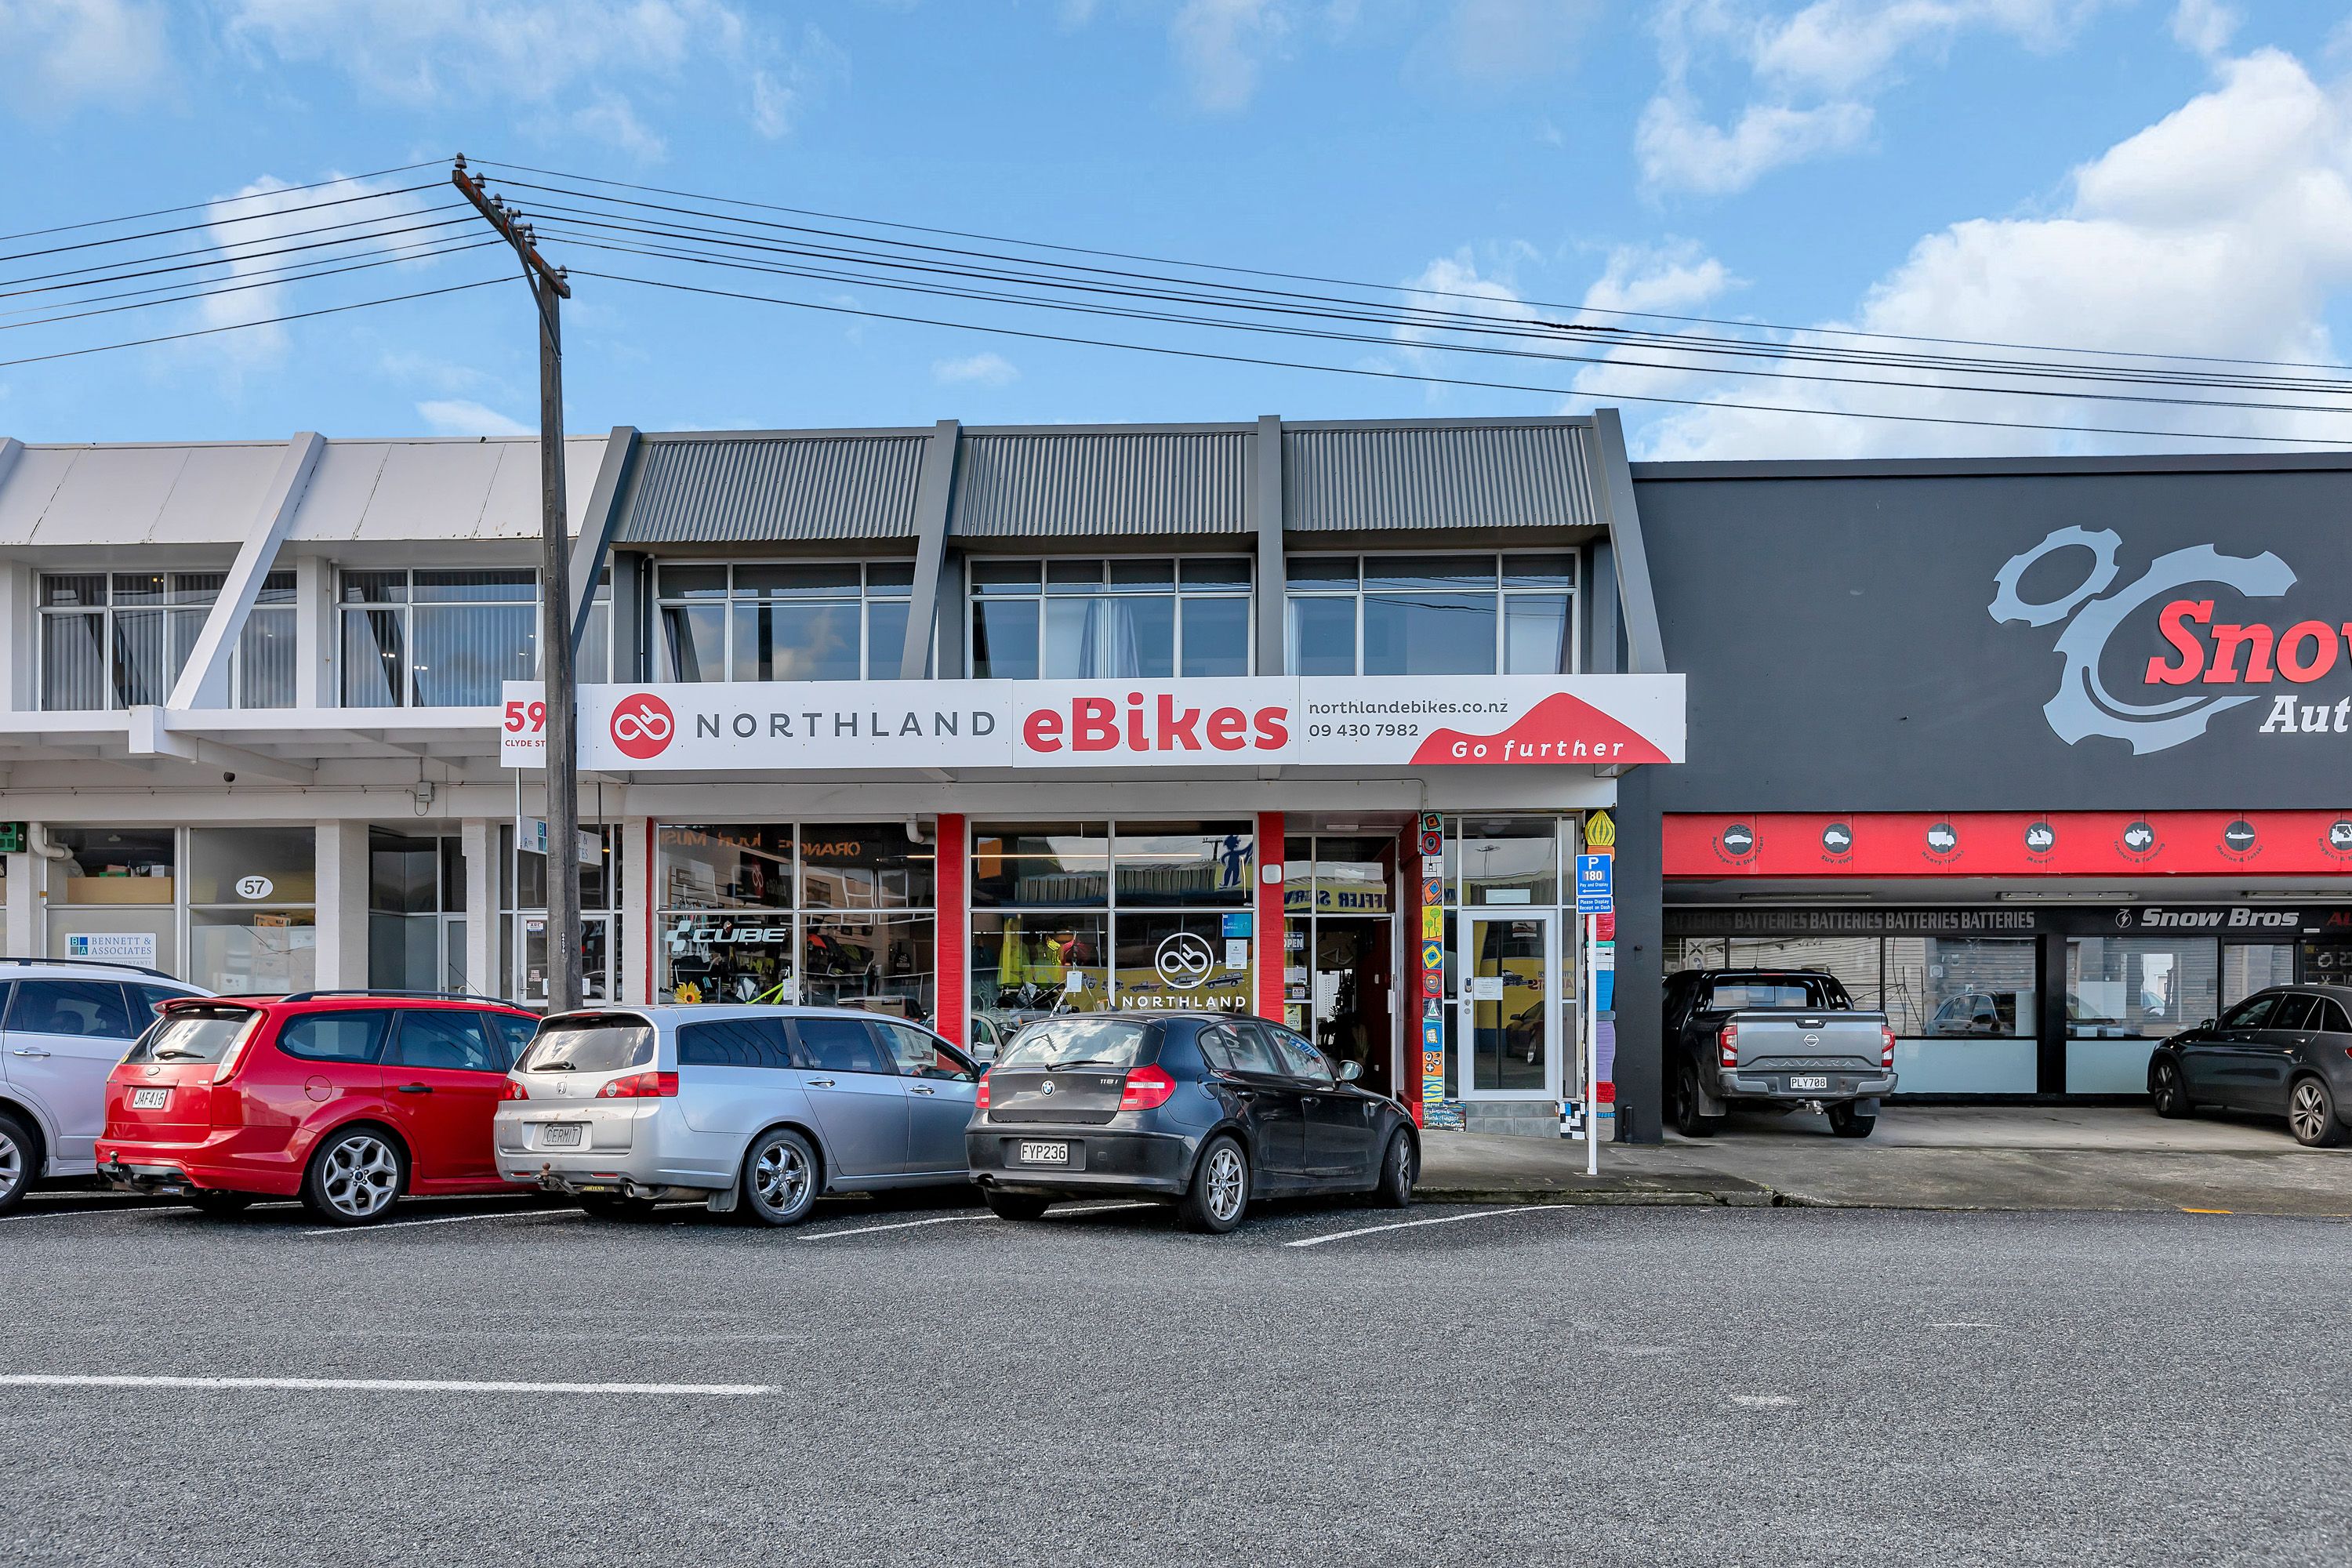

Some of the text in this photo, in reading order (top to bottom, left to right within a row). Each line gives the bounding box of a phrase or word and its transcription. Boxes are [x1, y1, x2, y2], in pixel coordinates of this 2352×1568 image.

[2144, 600, 2352, 684] Sno
[1308, 699, 1508, 715] northlandebikes.co.nz
[504, 701, 546, 733] 59
[1023, 691, 1289, 753] eBikes
[696, 711, 996, 739] NORTHLAND
[1308, 724, 1419, 737] 09 430 7982
[1451, 739, 1624, 761] Go further
[1588, 857, 1599, 870] P
[1584, 870, 1602, 881] 180
[244, 880, 265, 895] 57
[1734, 913, 1807, 929] BATTERIES
[1809, 913, 1882, 929] BATTERIES
[1886, 913, 1958, 929] BATTERIES
[1961, 912, 2034, 928] BATTERIES
[2141, 908, 2299, 927] Snow Bros
[692, 928, 786, 942] CUBE
[1123, 996, 1246, 1008] NORTHLAND
[1791, 1078, 1826, 1087] PLY708
[135, 1092, 165, 1105] JAF416
[546, 1129, 578, 1143] CERMIT
[1022, 1145, 1066, 1160] FYP236
